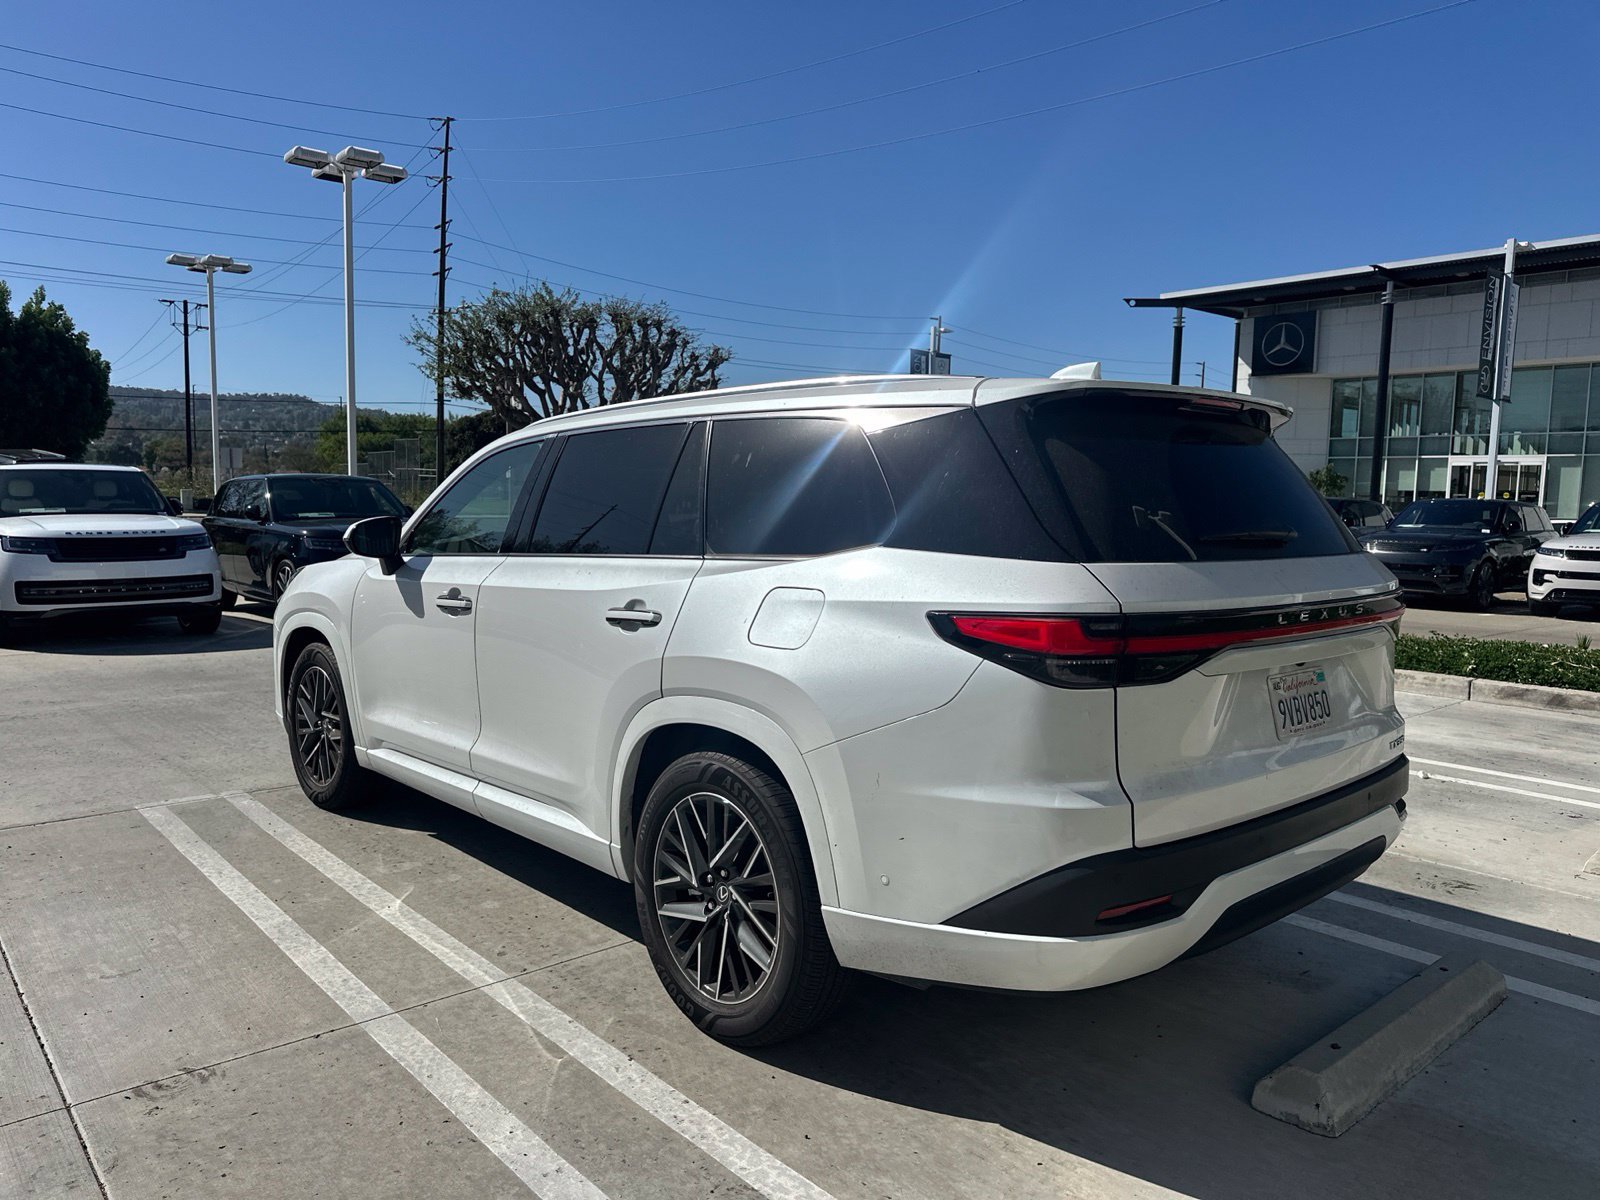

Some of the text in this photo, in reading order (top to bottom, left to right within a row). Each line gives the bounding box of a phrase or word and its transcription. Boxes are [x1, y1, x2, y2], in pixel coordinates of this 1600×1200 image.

[1482, 276, 1497, 360] ENVISION
[1278, 604, 1364, 625] LEXUS
[1281, 676, 1317, 694] California
[1278, 690, 1331, 729] 9VBV850
